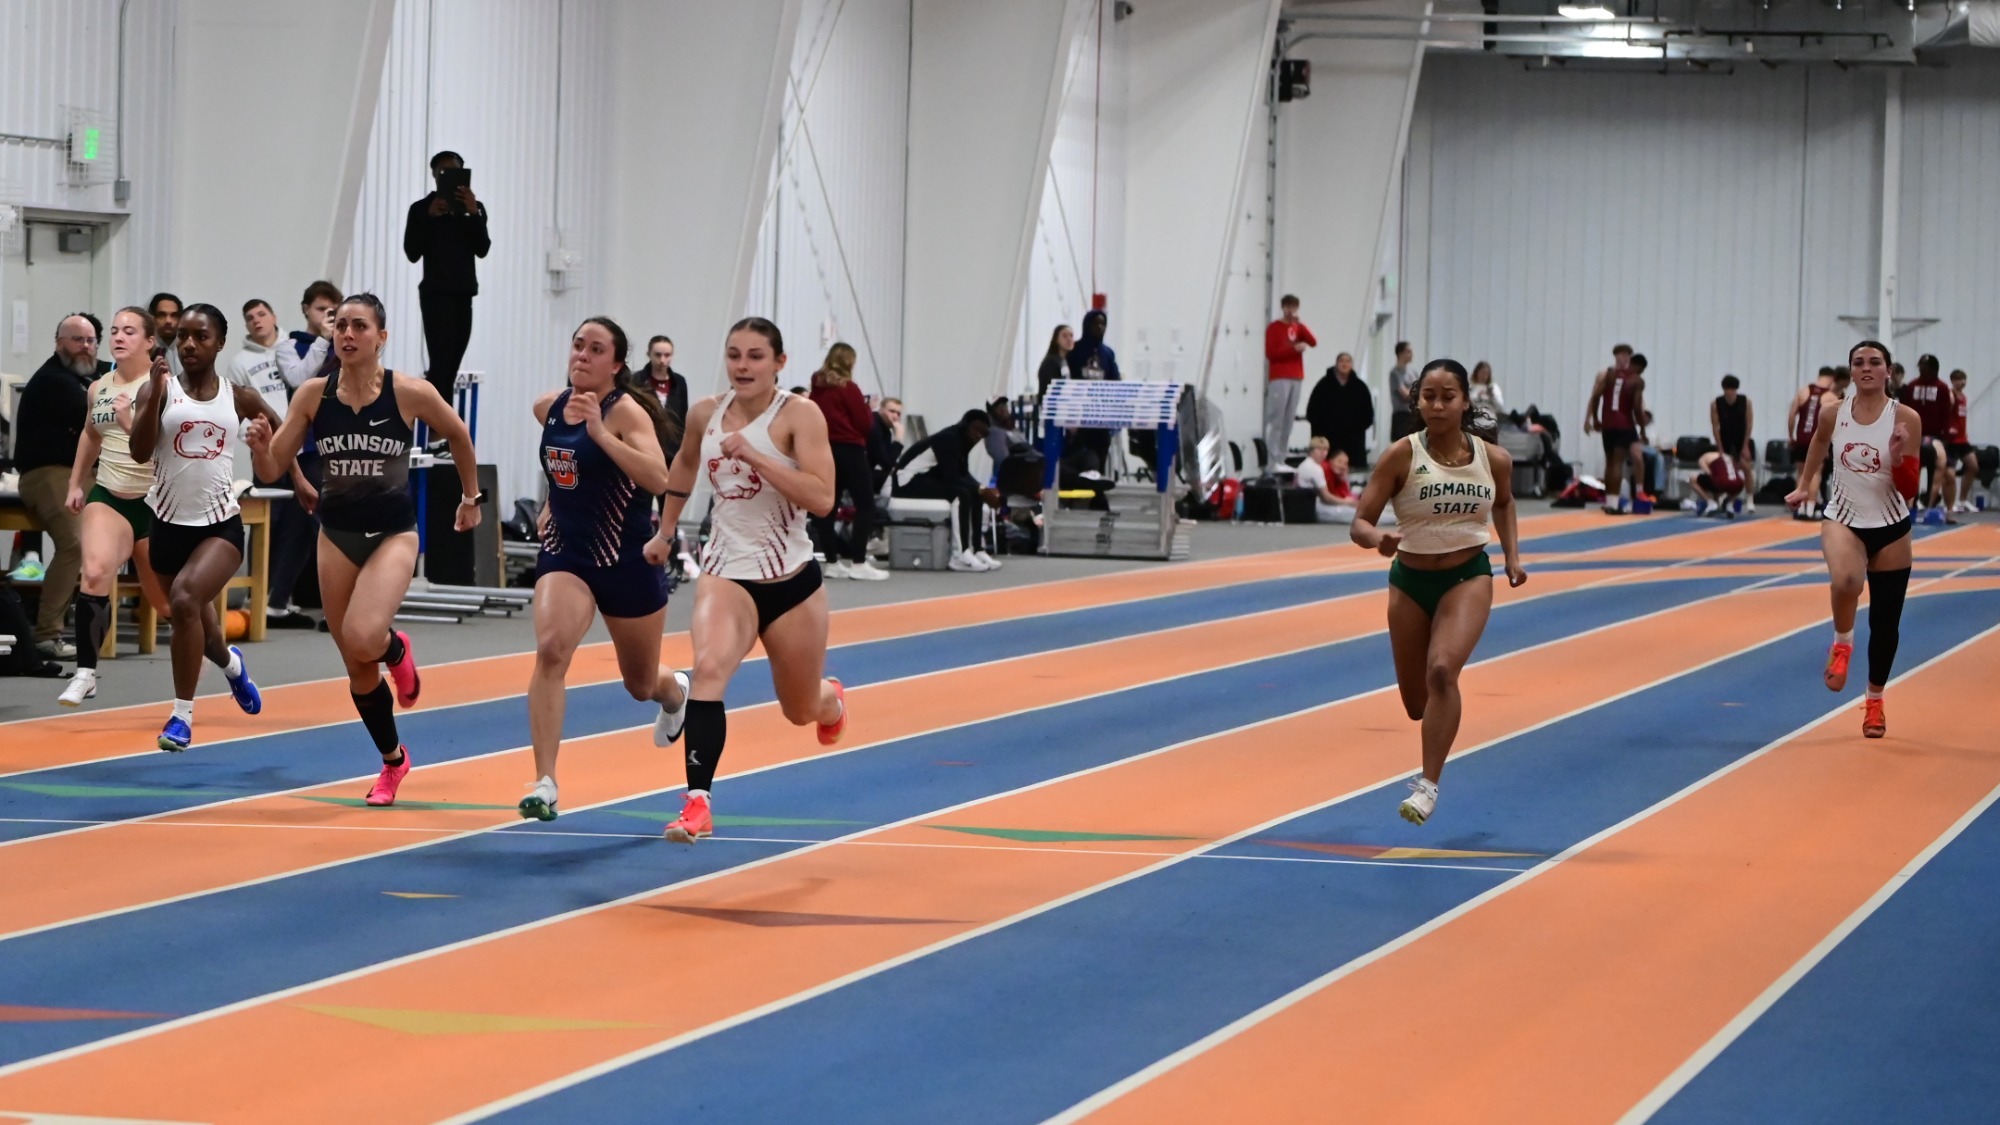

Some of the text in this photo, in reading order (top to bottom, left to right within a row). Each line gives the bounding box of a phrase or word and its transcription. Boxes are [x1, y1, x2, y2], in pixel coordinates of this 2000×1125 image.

[92, 411, 116, 424] STAT
[329, 459, 386, 476] STATE
[547, 459, 576, 474] MARY
[1419, 482, 1491, 500] BISMARCK
[1432, 502, 1480, 514] STATE
